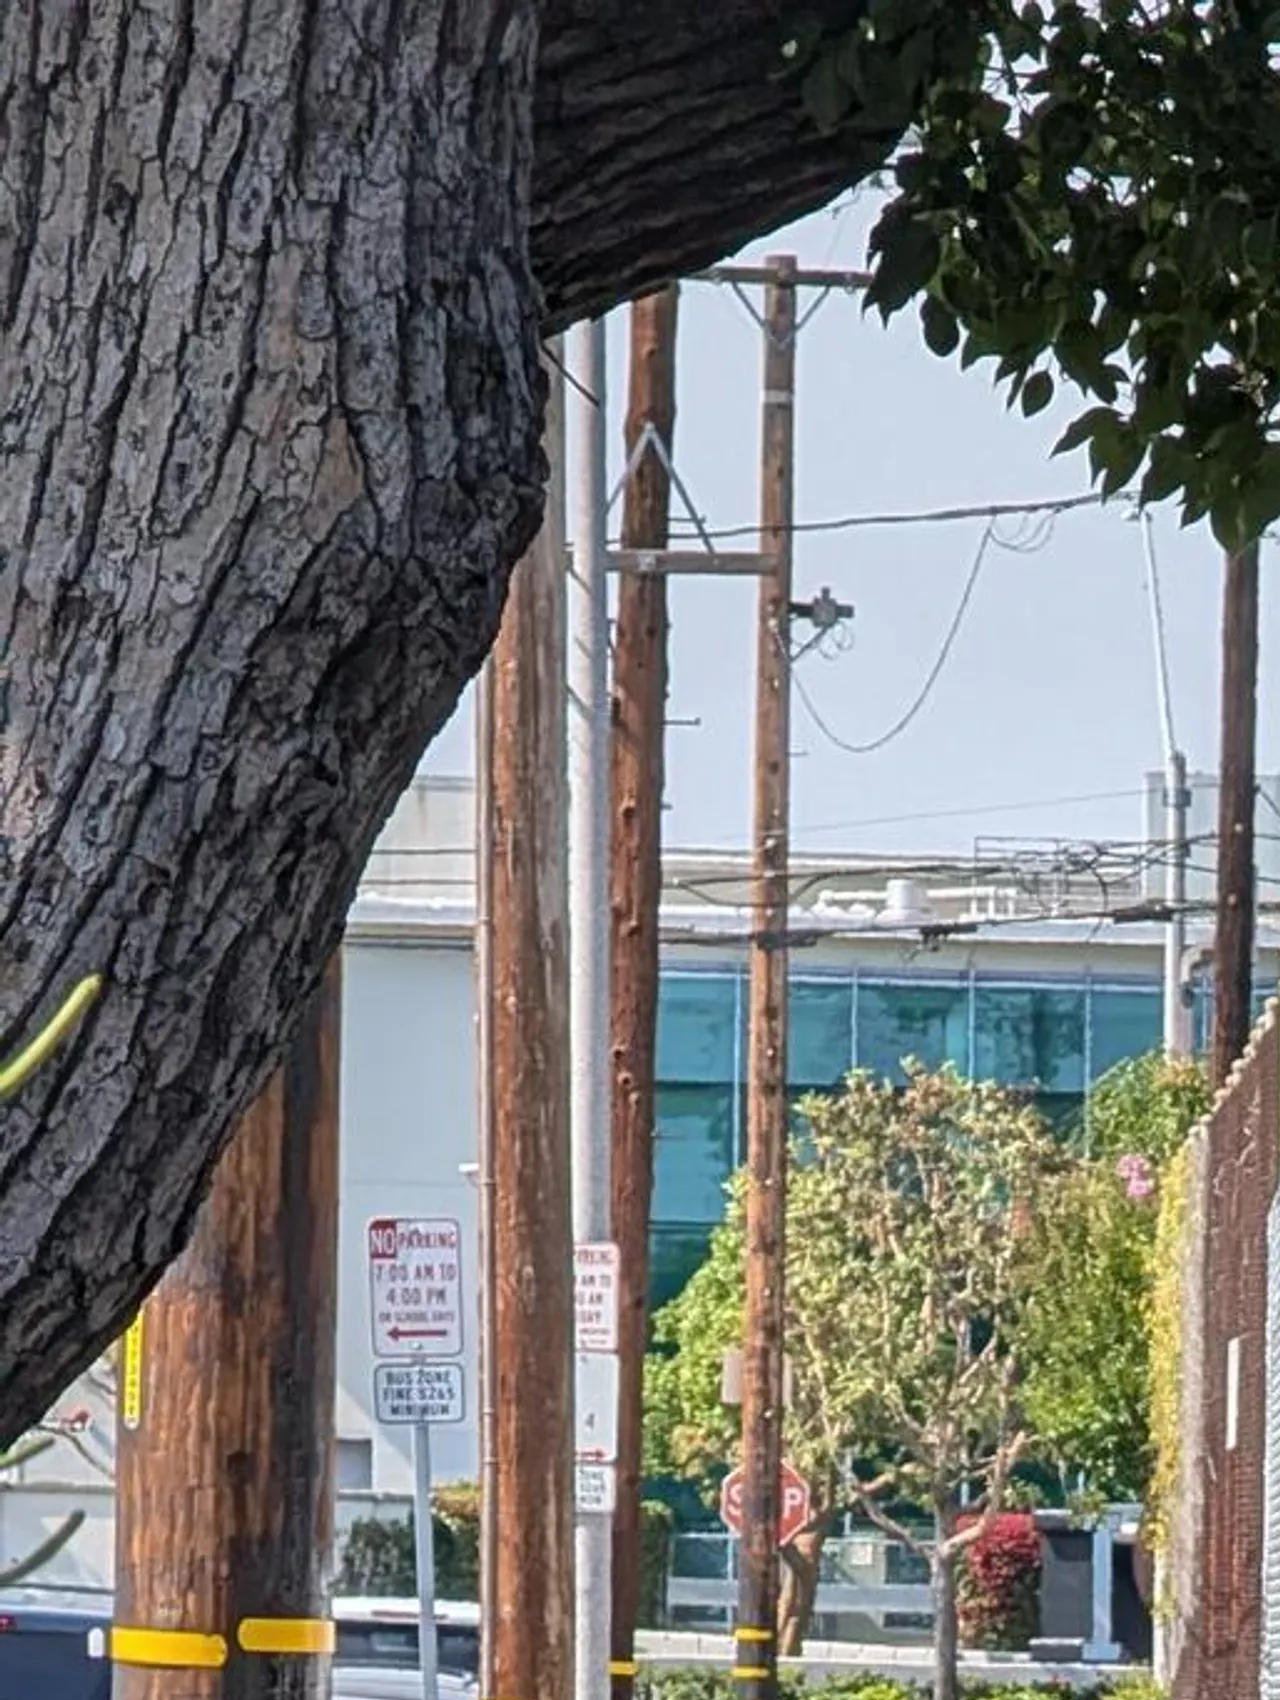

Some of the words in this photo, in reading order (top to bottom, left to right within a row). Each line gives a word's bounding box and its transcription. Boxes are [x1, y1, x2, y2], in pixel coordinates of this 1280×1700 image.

[371, 1228, 395, 1255] NO
[398, 1229, 457, 1249] PARKING
[414, 1263, 435, 1281] AM
[438, 1263, 457, 1281] TO
[426, 1286, 447, 1305] PM
[391, 1404, 450, 1416] MINIMUM
[727, 1484, 804, 1518] SP
